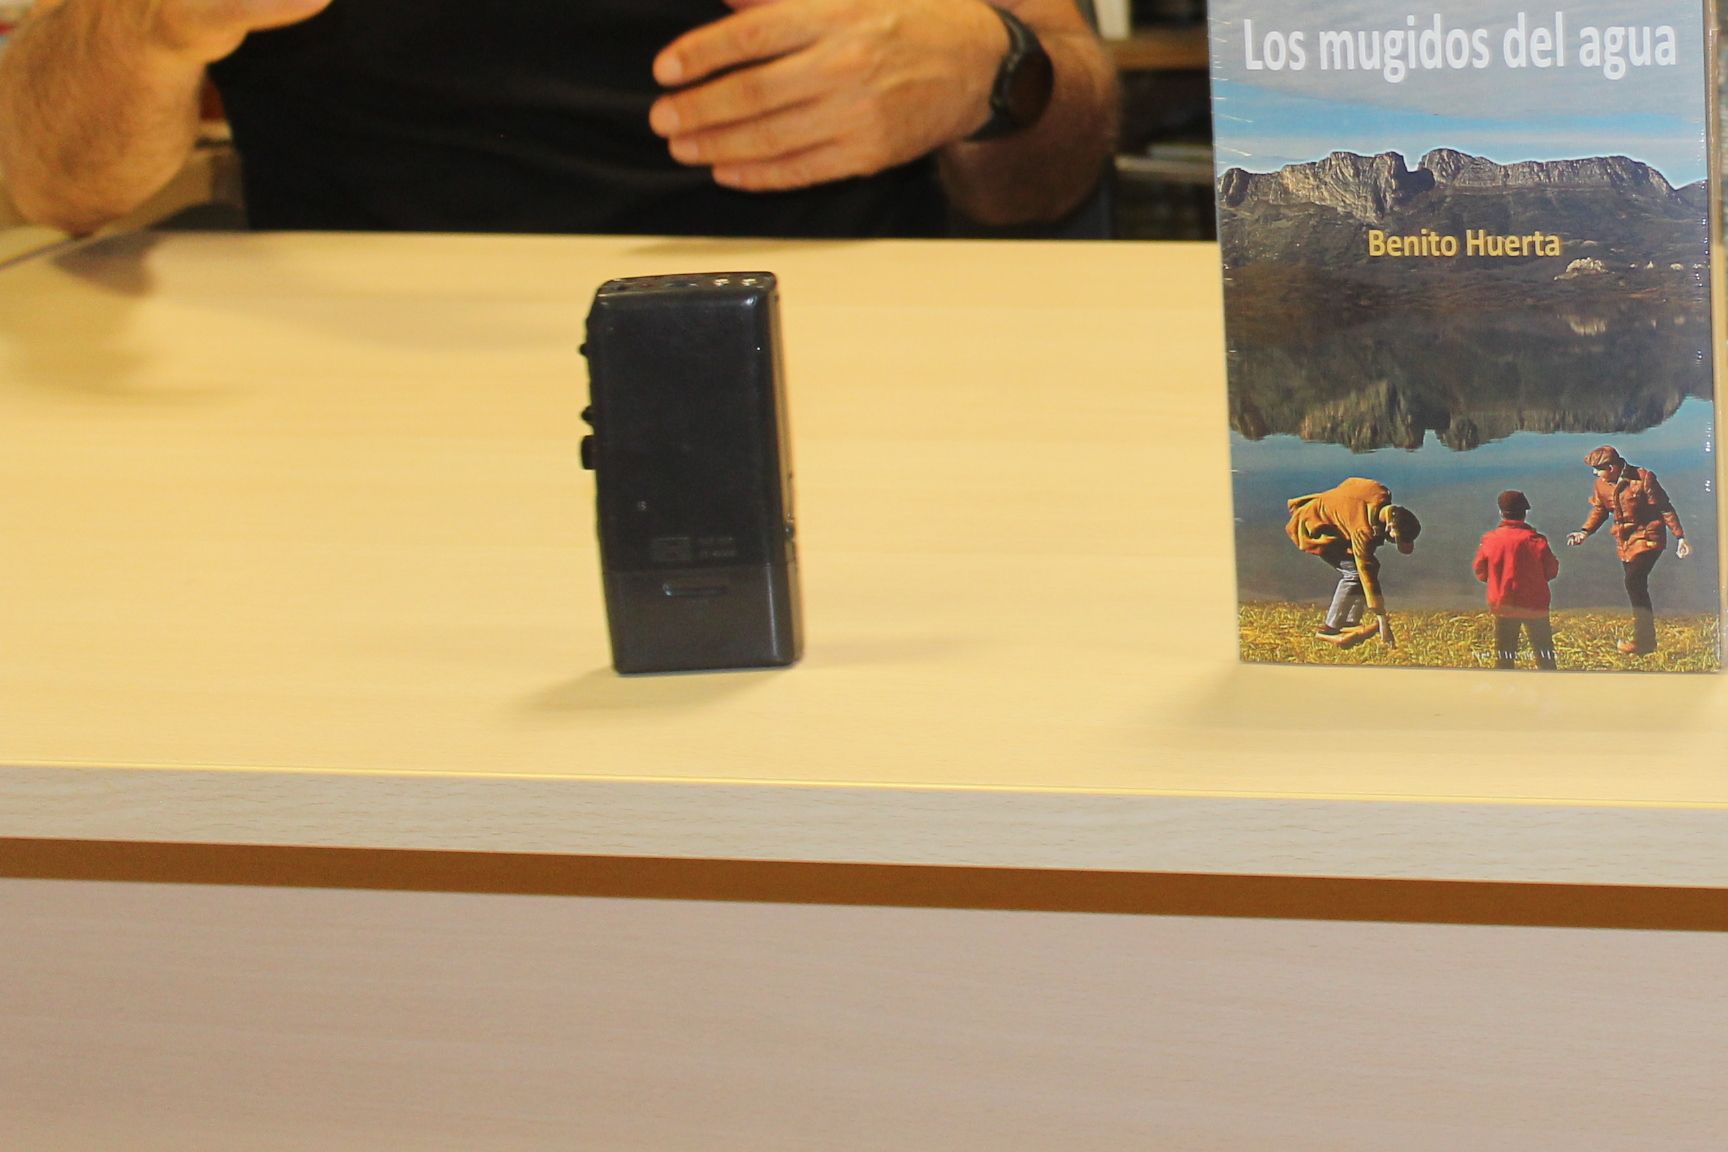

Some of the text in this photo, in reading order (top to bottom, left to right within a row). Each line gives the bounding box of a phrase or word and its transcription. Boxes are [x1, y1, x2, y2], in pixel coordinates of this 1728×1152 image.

[1242, 10, 1678, 84] Los mugidos del agua
[1367, 228, 1562, 258] Benito Huerta
